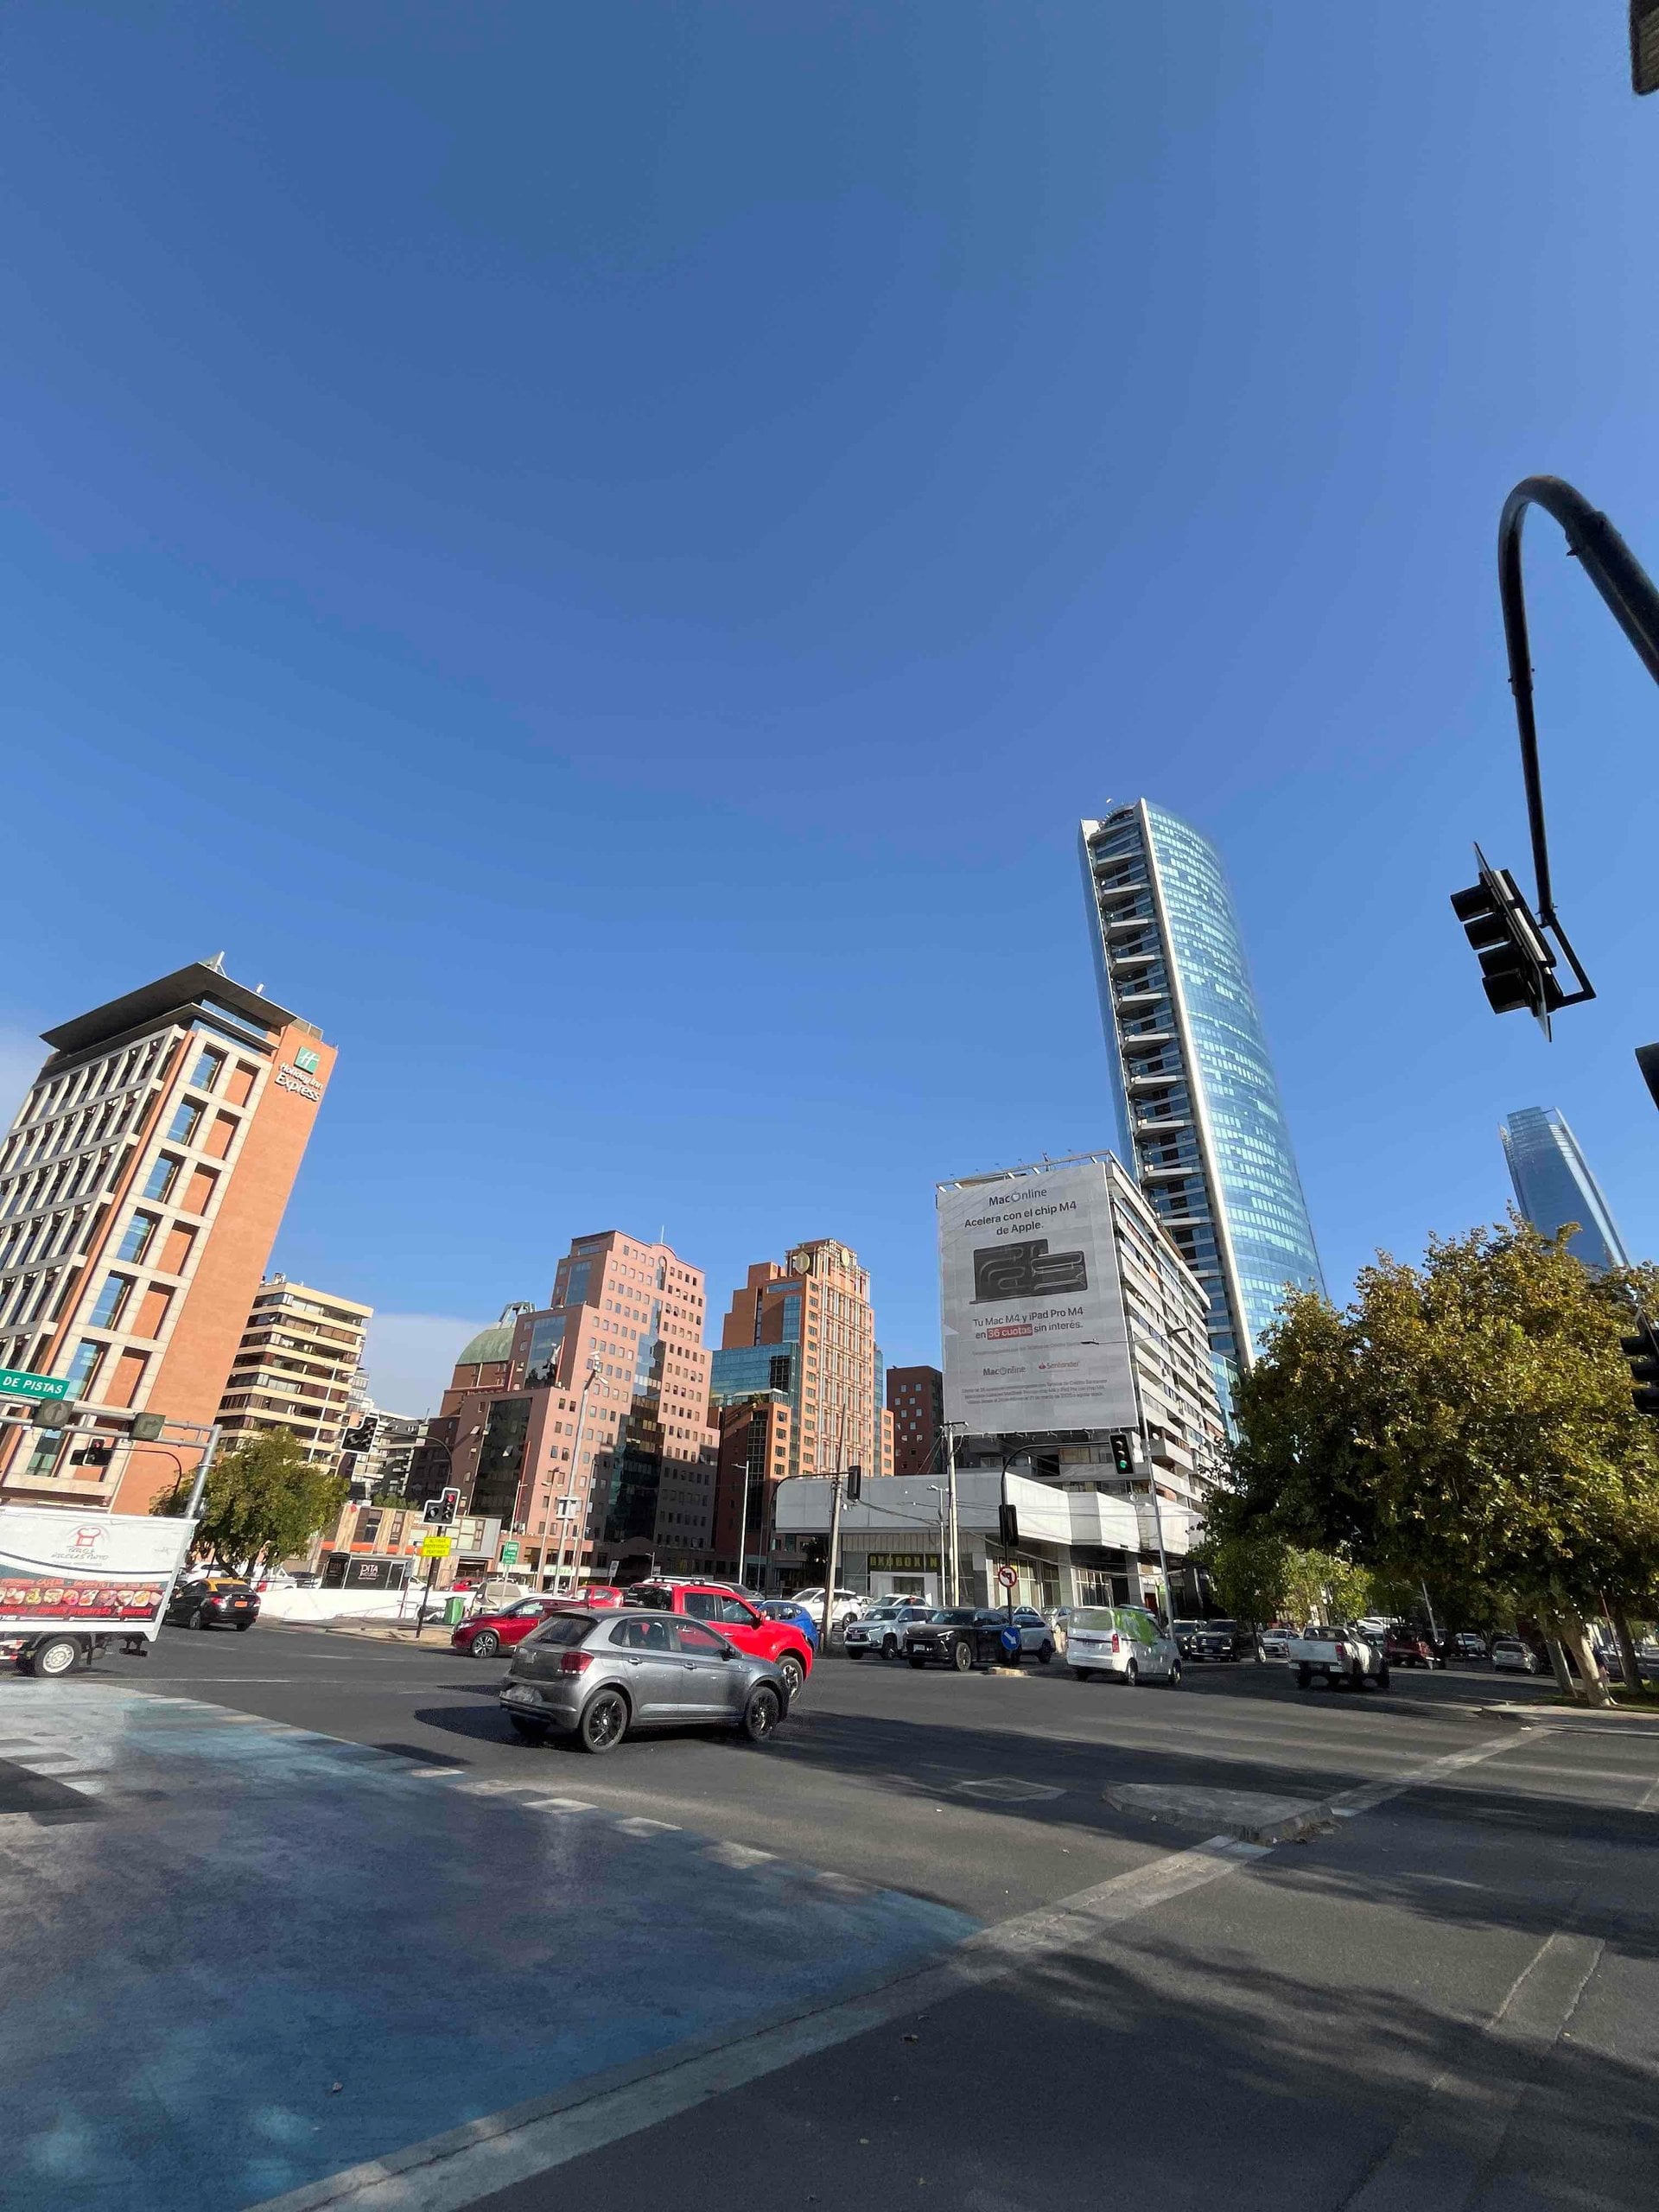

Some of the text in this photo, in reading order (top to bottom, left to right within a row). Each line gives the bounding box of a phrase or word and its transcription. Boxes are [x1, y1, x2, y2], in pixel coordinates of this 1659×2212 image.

[279, 1062, 323, 1090] Holiday Inn
[275, 1072, 321, 1102] Express
[964, 1201, 1077, 1228] Acelera con el chip M4
[996, 1221, 1044, 1236] de Apple.
[1006, 1313, 1020, 1323] M4
[1029, 1310, 1049, 1320] iPad
[1051, 1309, 1066, 1318] Pro
[1068, 1306, 1084, 1316] M4
[988, 1329, 1000, 1338] 36
[1001, 1326, 1033, 1337] cuotas
[1033, 1324, 1047, 1332] sin
[3, 1376, 63, 1394] DE PISTAS
[359, 1564, 378, 1574] PITA
